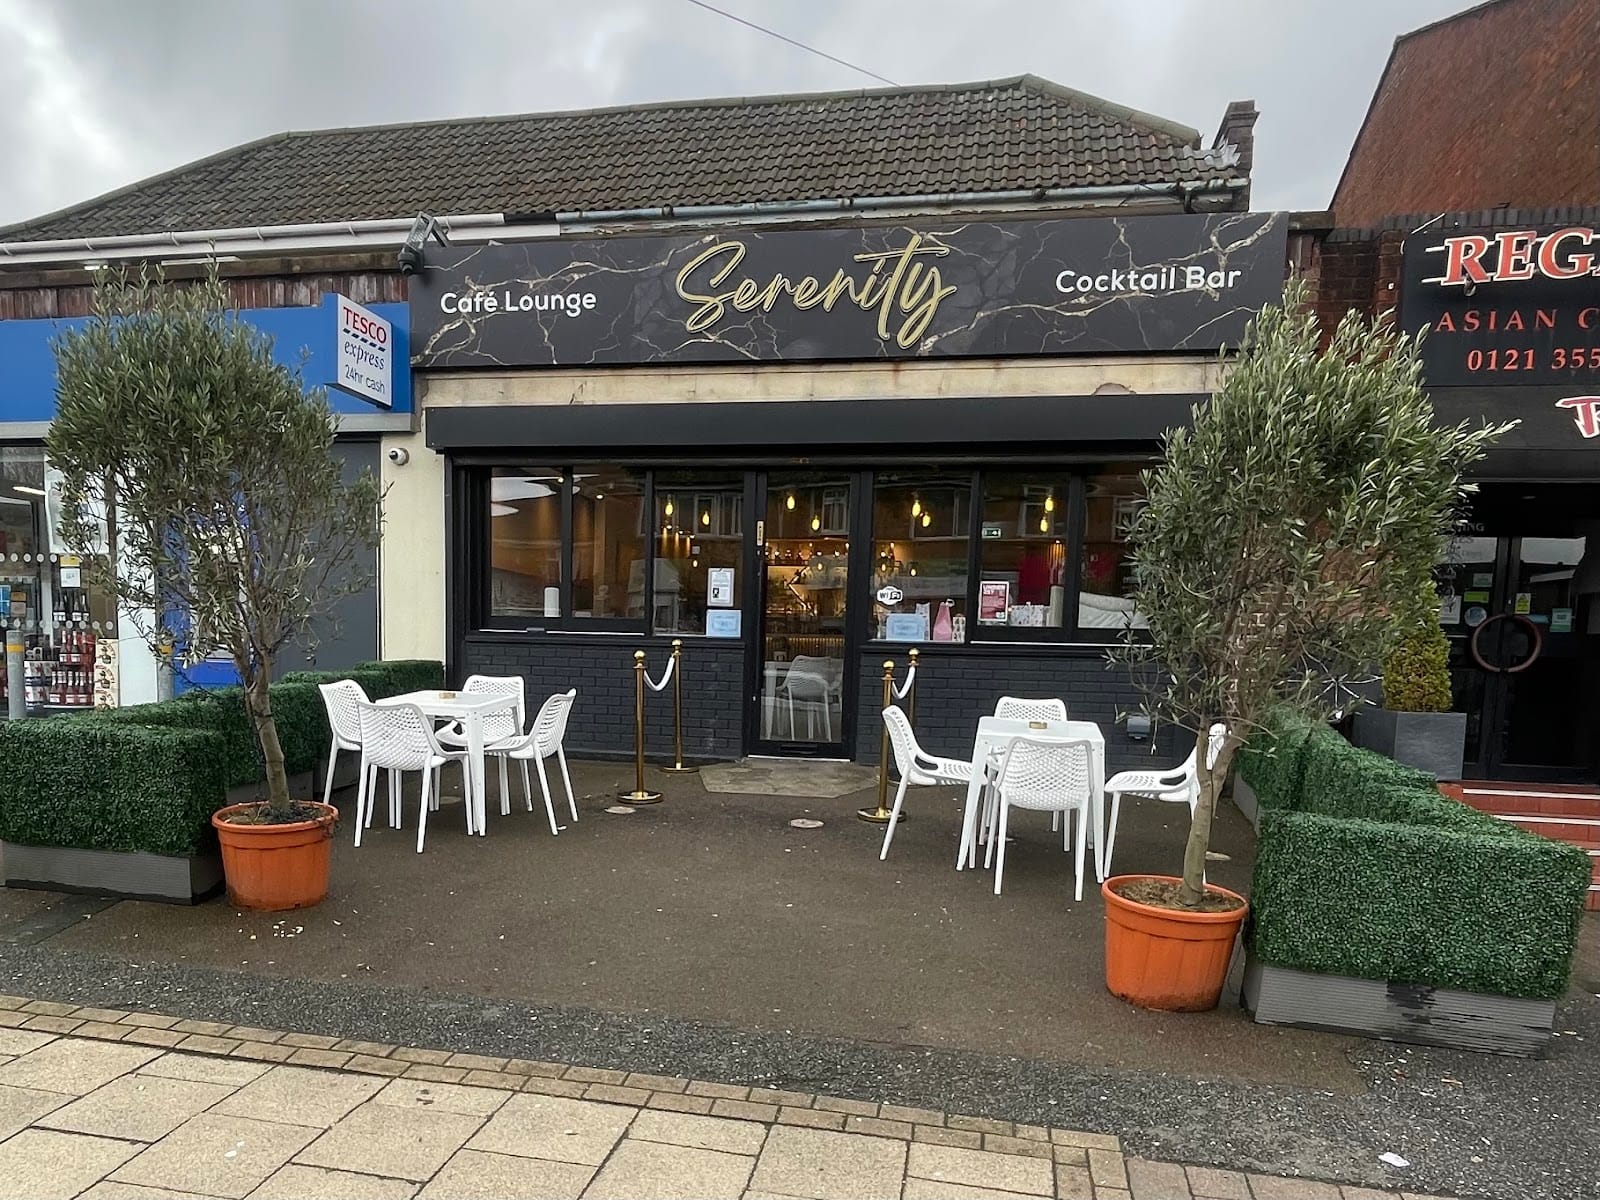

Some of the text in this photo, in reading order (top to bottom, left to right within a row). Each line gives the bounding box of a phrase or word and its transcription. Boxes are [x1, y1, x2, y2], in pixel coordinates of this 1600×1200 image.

[1441, 227, 1600, 286] REG
[675, 233, 958, 349] Serenity
[1055, 265, 1242, 293] Cocktail Bar
[440, 290, 597, 318] Café Lounge
[343, 306, 387, 344] TESCO
[1434, 308, 1558, 333] ASIAN
[344, 341, 385, 370] express
[1467, 348, 1600, 371] 0121 355
[344, 363, 385, 395] 24hr cash
